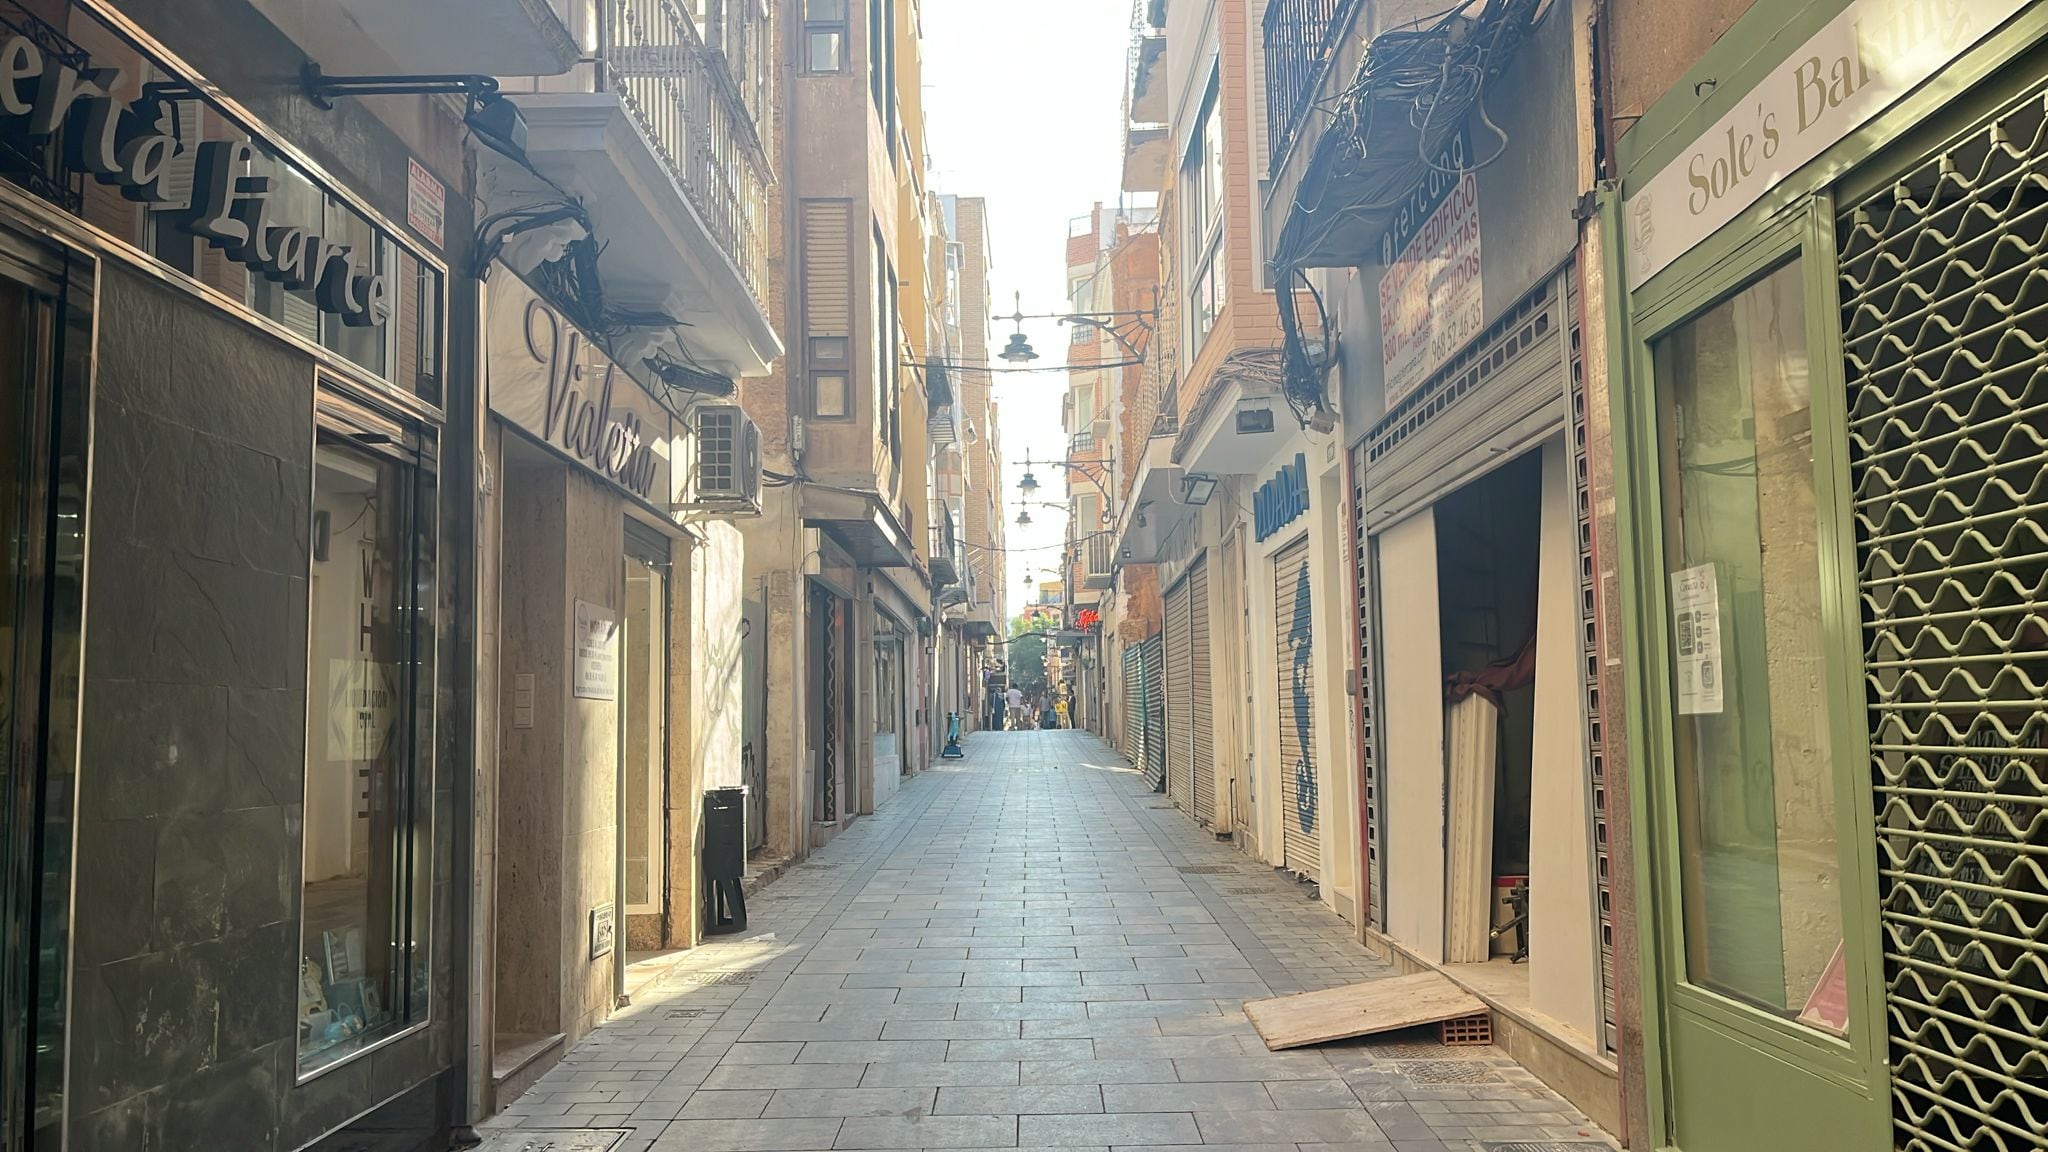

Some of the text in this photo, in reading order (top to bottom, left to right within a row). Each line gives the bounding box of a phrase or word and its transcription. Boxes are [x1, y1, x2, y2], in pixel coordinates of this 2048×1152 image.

[1687, 103, 1780, 216] Sole's
[1380, 273, 1391, 309] SE
[1392, 235, 1422, 295] VENDE
[1382, 296, 1400, 336] BAJO
[1431, 330, 1446, 366] 968
[1446, 319, 1456, 352] 52
[1458, 308, 1468, 341] 46
[1470, 297, 1481, 331] 35
[522, 298, 657, 498] Violetta
